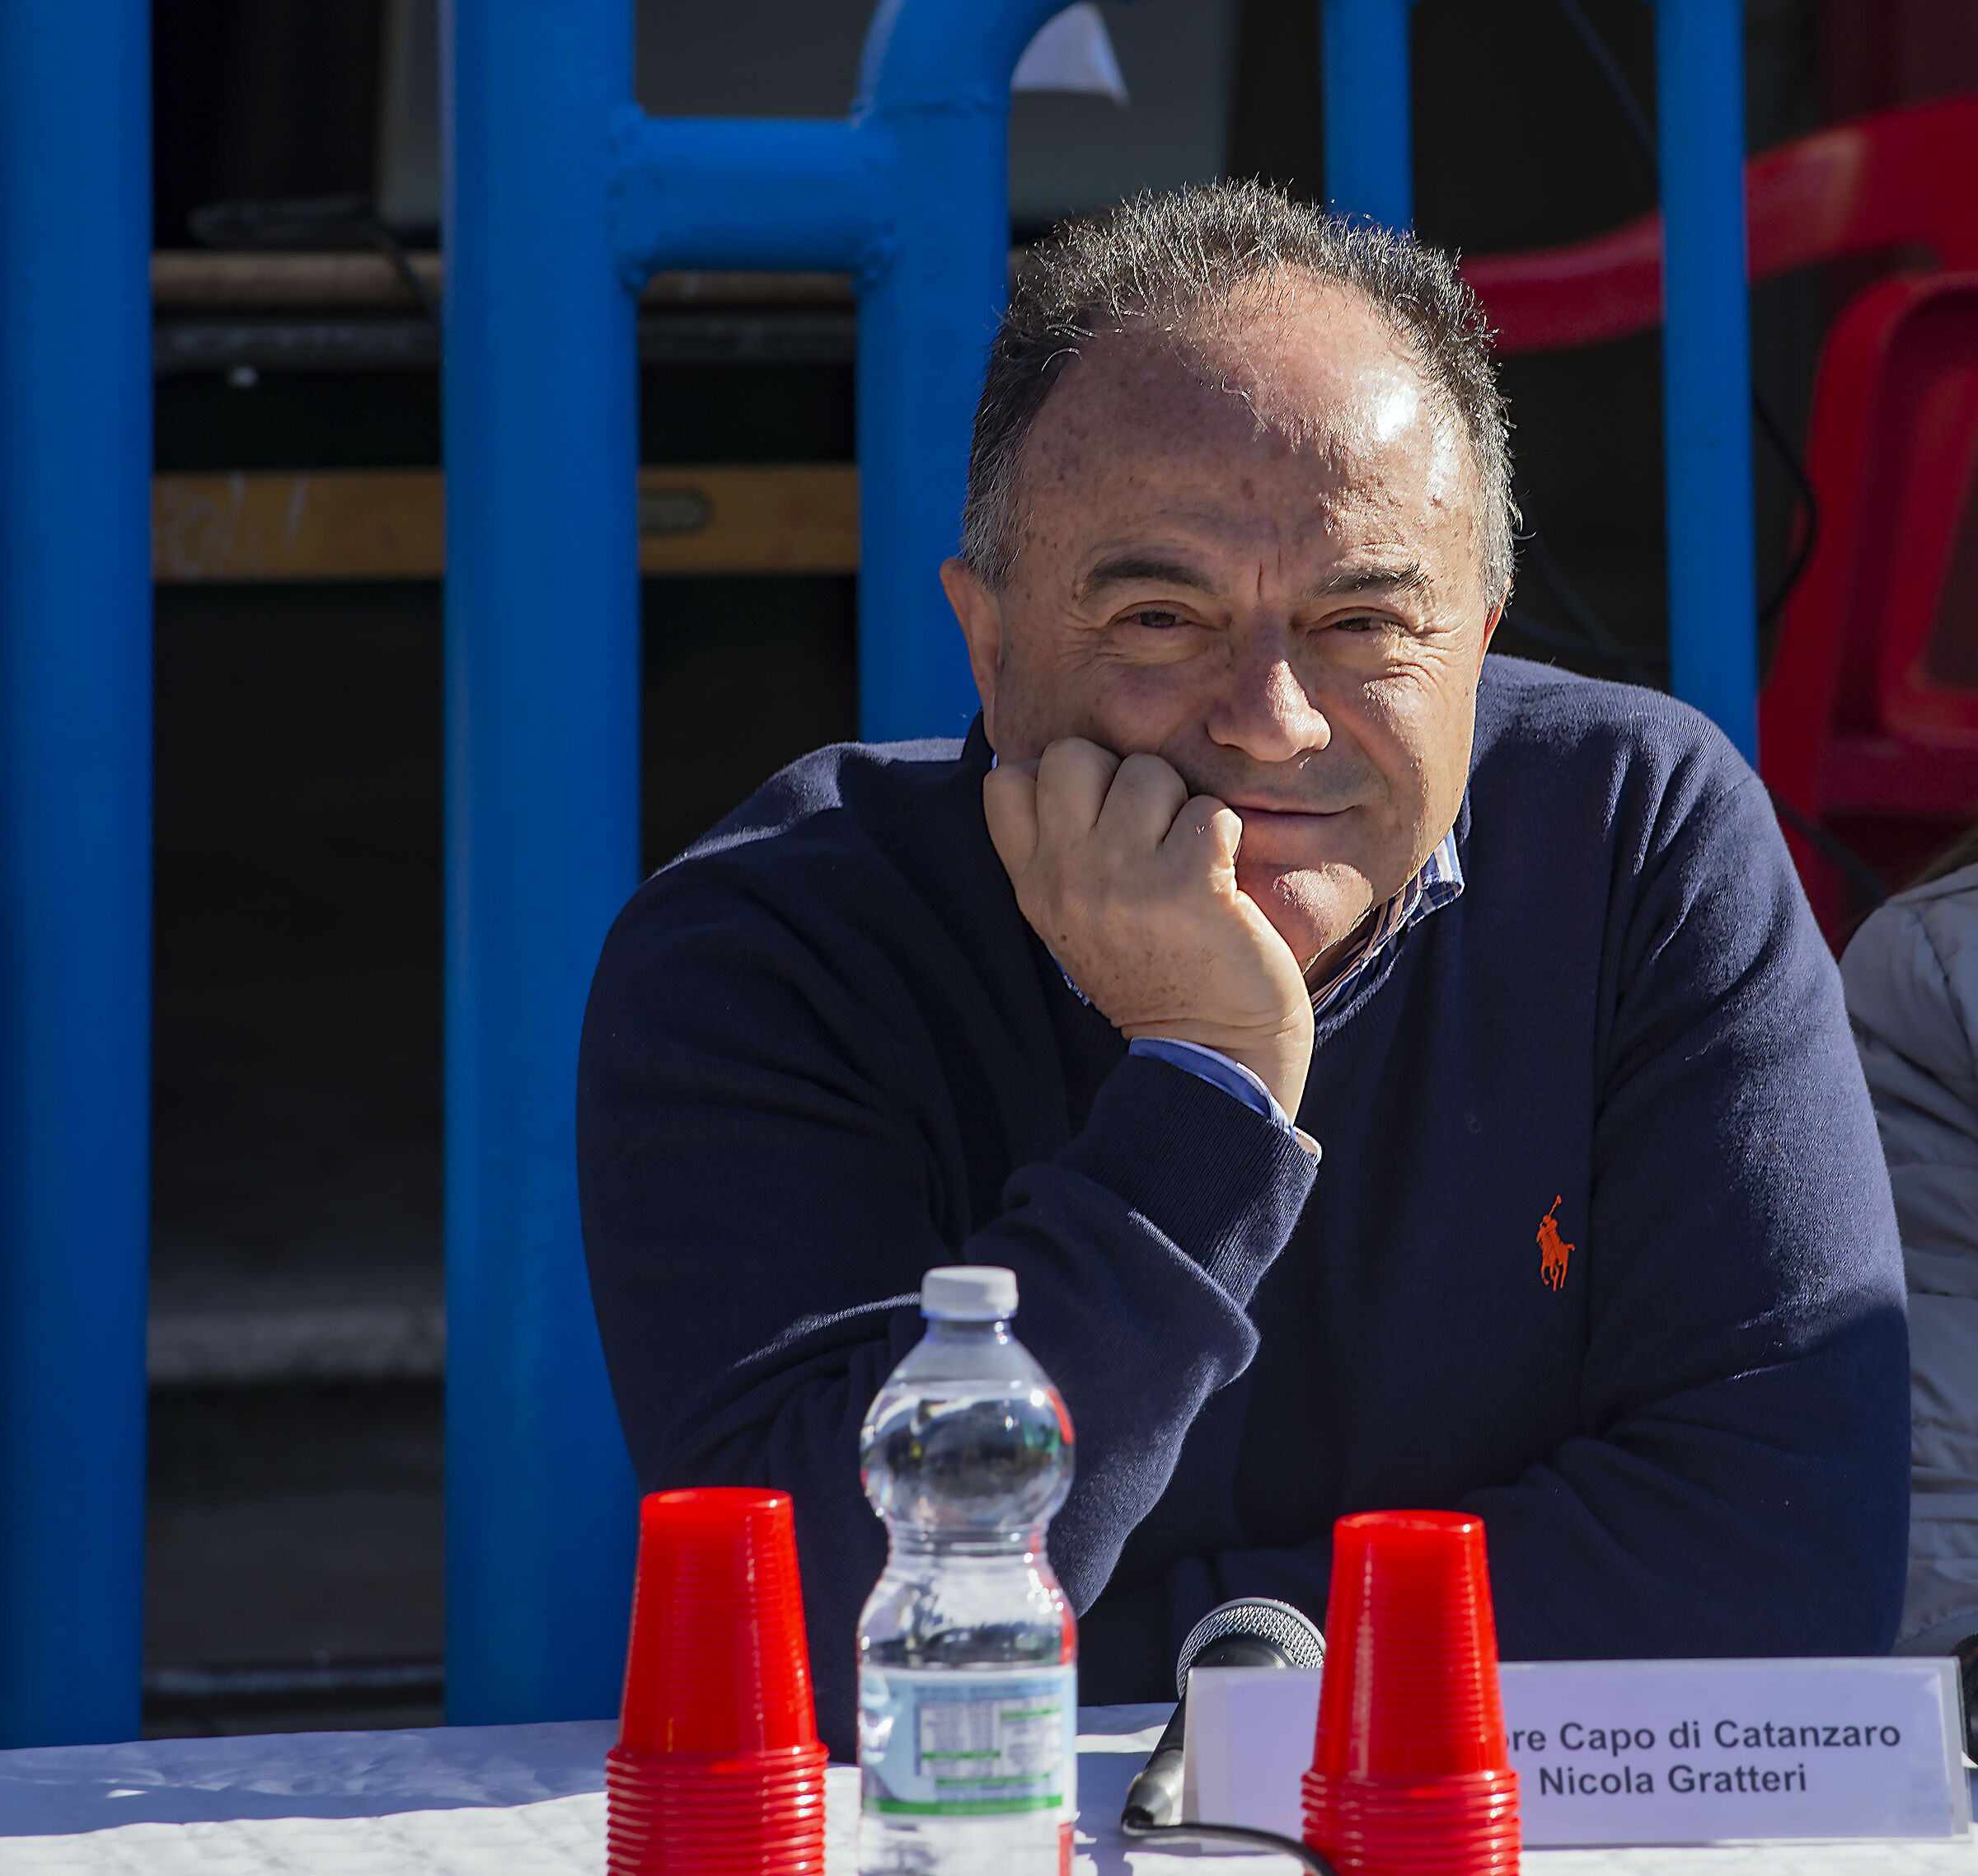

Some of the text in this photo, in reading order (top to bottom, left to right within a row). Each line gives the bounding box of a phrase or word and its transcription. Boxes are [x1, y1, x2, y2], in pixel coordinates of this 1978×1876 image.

[1505, 1719, 1901, 1758] re Capo di Catanzaro
[1539, 1762, 1807, 1796] Nicola Gratteri
